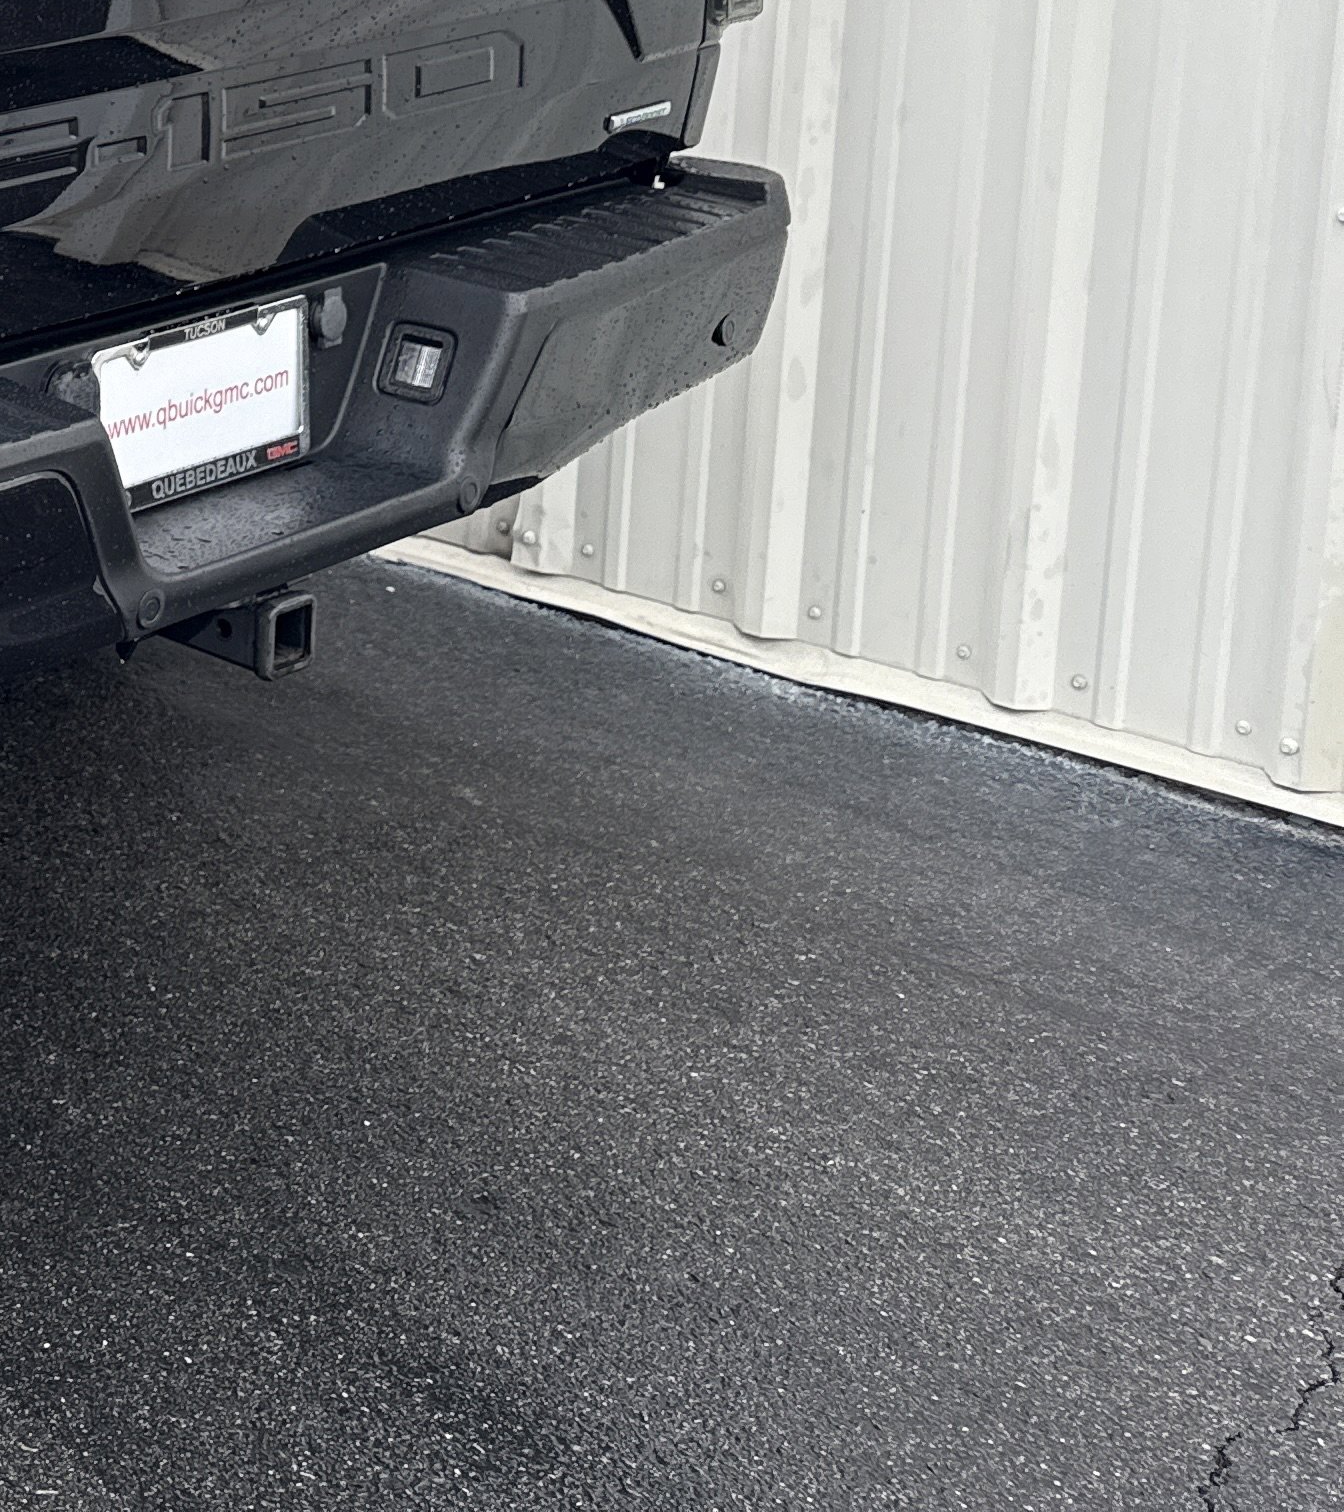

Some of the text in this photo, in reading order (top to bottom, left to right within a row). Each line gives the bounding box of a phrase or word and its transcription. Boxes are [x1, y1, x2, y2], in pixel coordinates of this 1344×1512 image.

[183, 318, 227, 341] TUCSON
[107, 369, 290, 440] www.qbuickgmc.com
[151, 440, 299, 500] QUEBEDEAUX GMC
